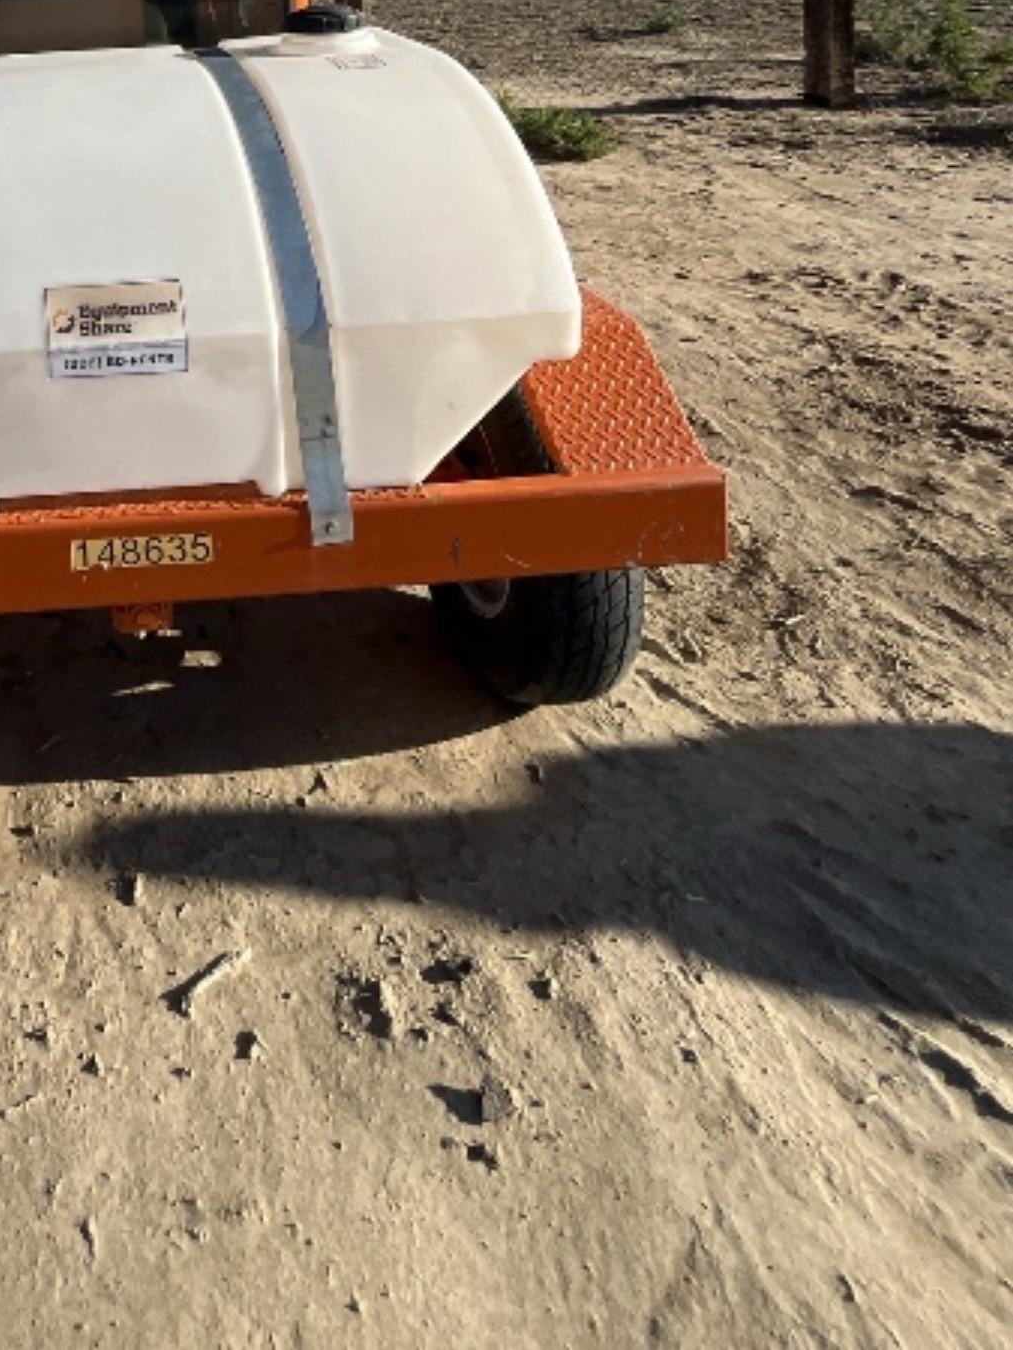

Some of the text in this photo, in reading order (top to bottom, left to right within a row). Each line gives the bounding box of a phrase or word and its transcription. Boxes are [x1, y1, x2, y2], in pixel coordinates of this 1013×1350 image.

[78, 299, 178, 322] Equipment
[79, 320, 133, 337] Share
[75, 533, 211, 567] 148635
